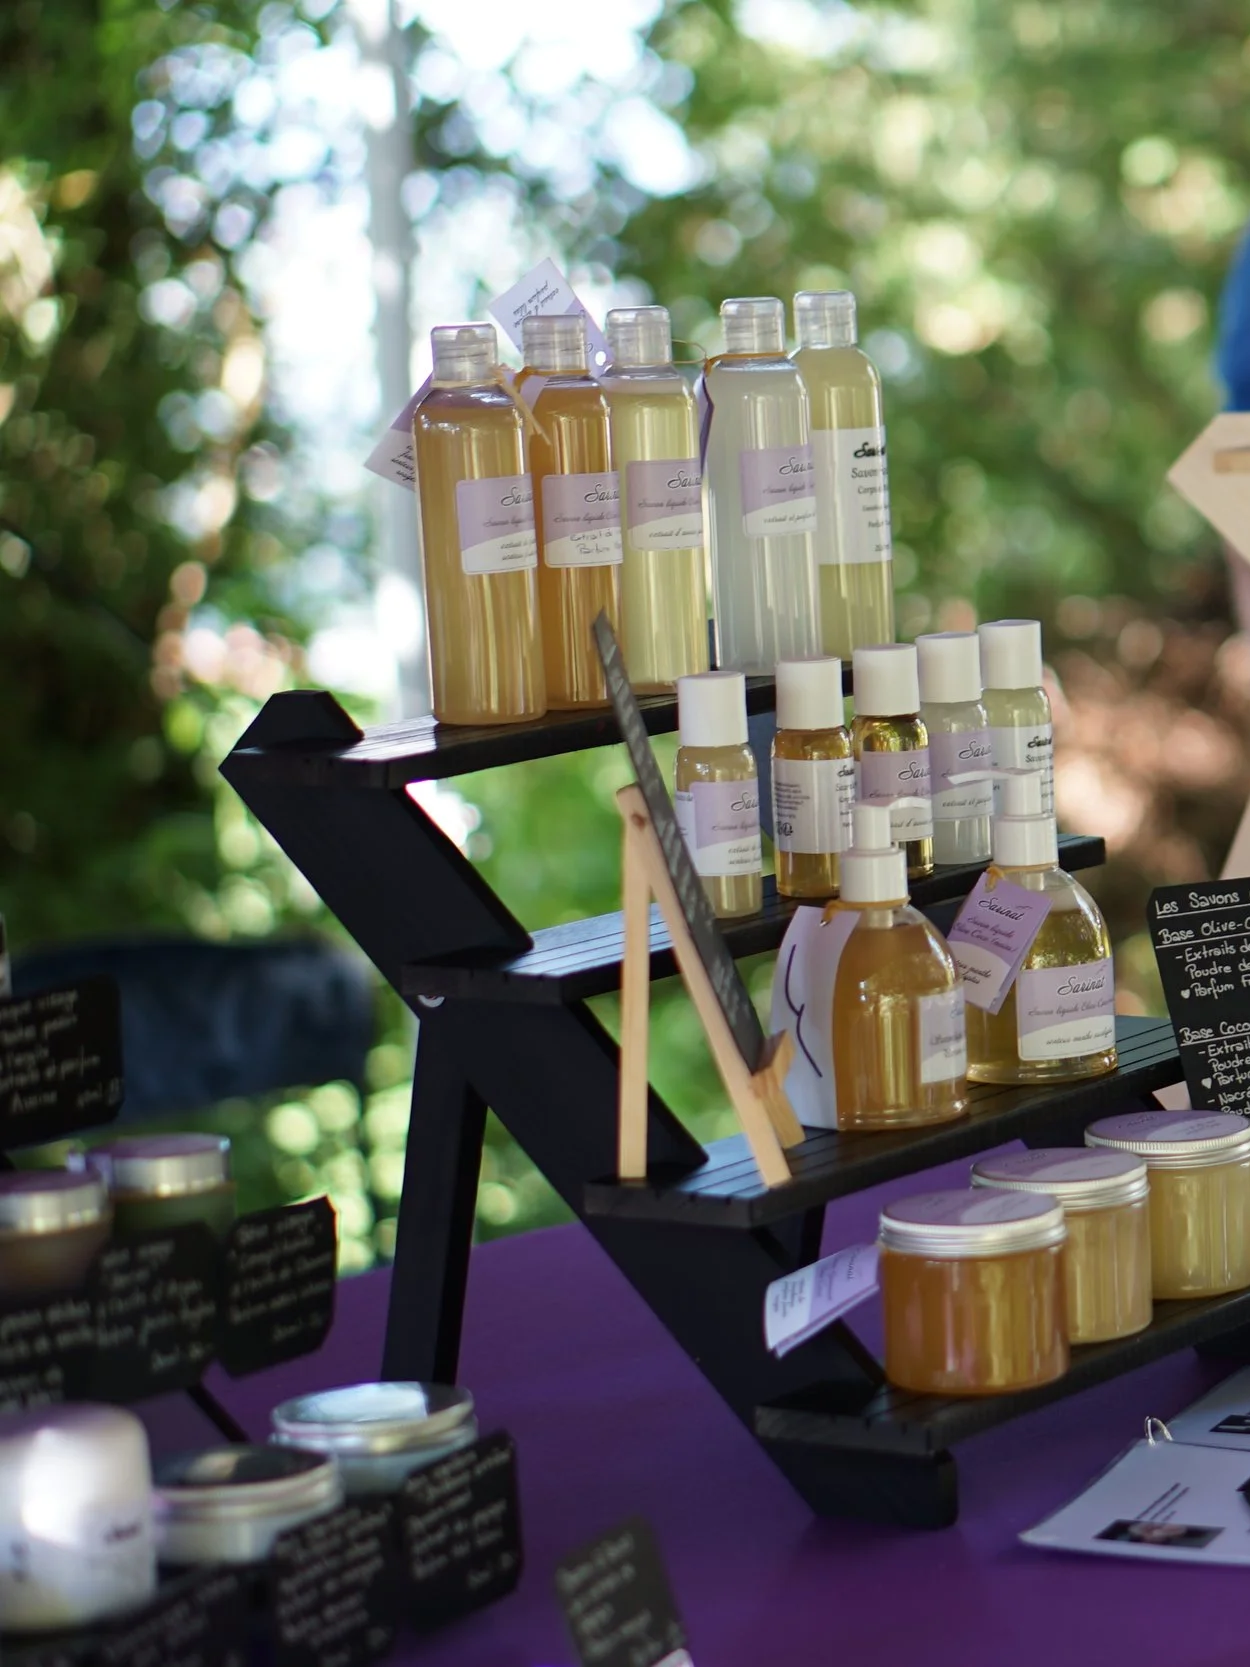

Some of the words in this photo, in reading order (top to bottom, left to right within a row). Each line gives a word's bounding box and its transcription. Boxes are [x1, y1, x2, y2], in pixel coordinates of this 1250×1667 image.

[1155, 900, 1179, 915] Les
[1189, 891, 1240, 908] Savons
[1158, 928, 1195, 944] Base
[1184, 961, 1232, 979] Poudre
[1190, 977, 1235, 1000] Parfum
[1179, 1027, 1215, 1044] Base
